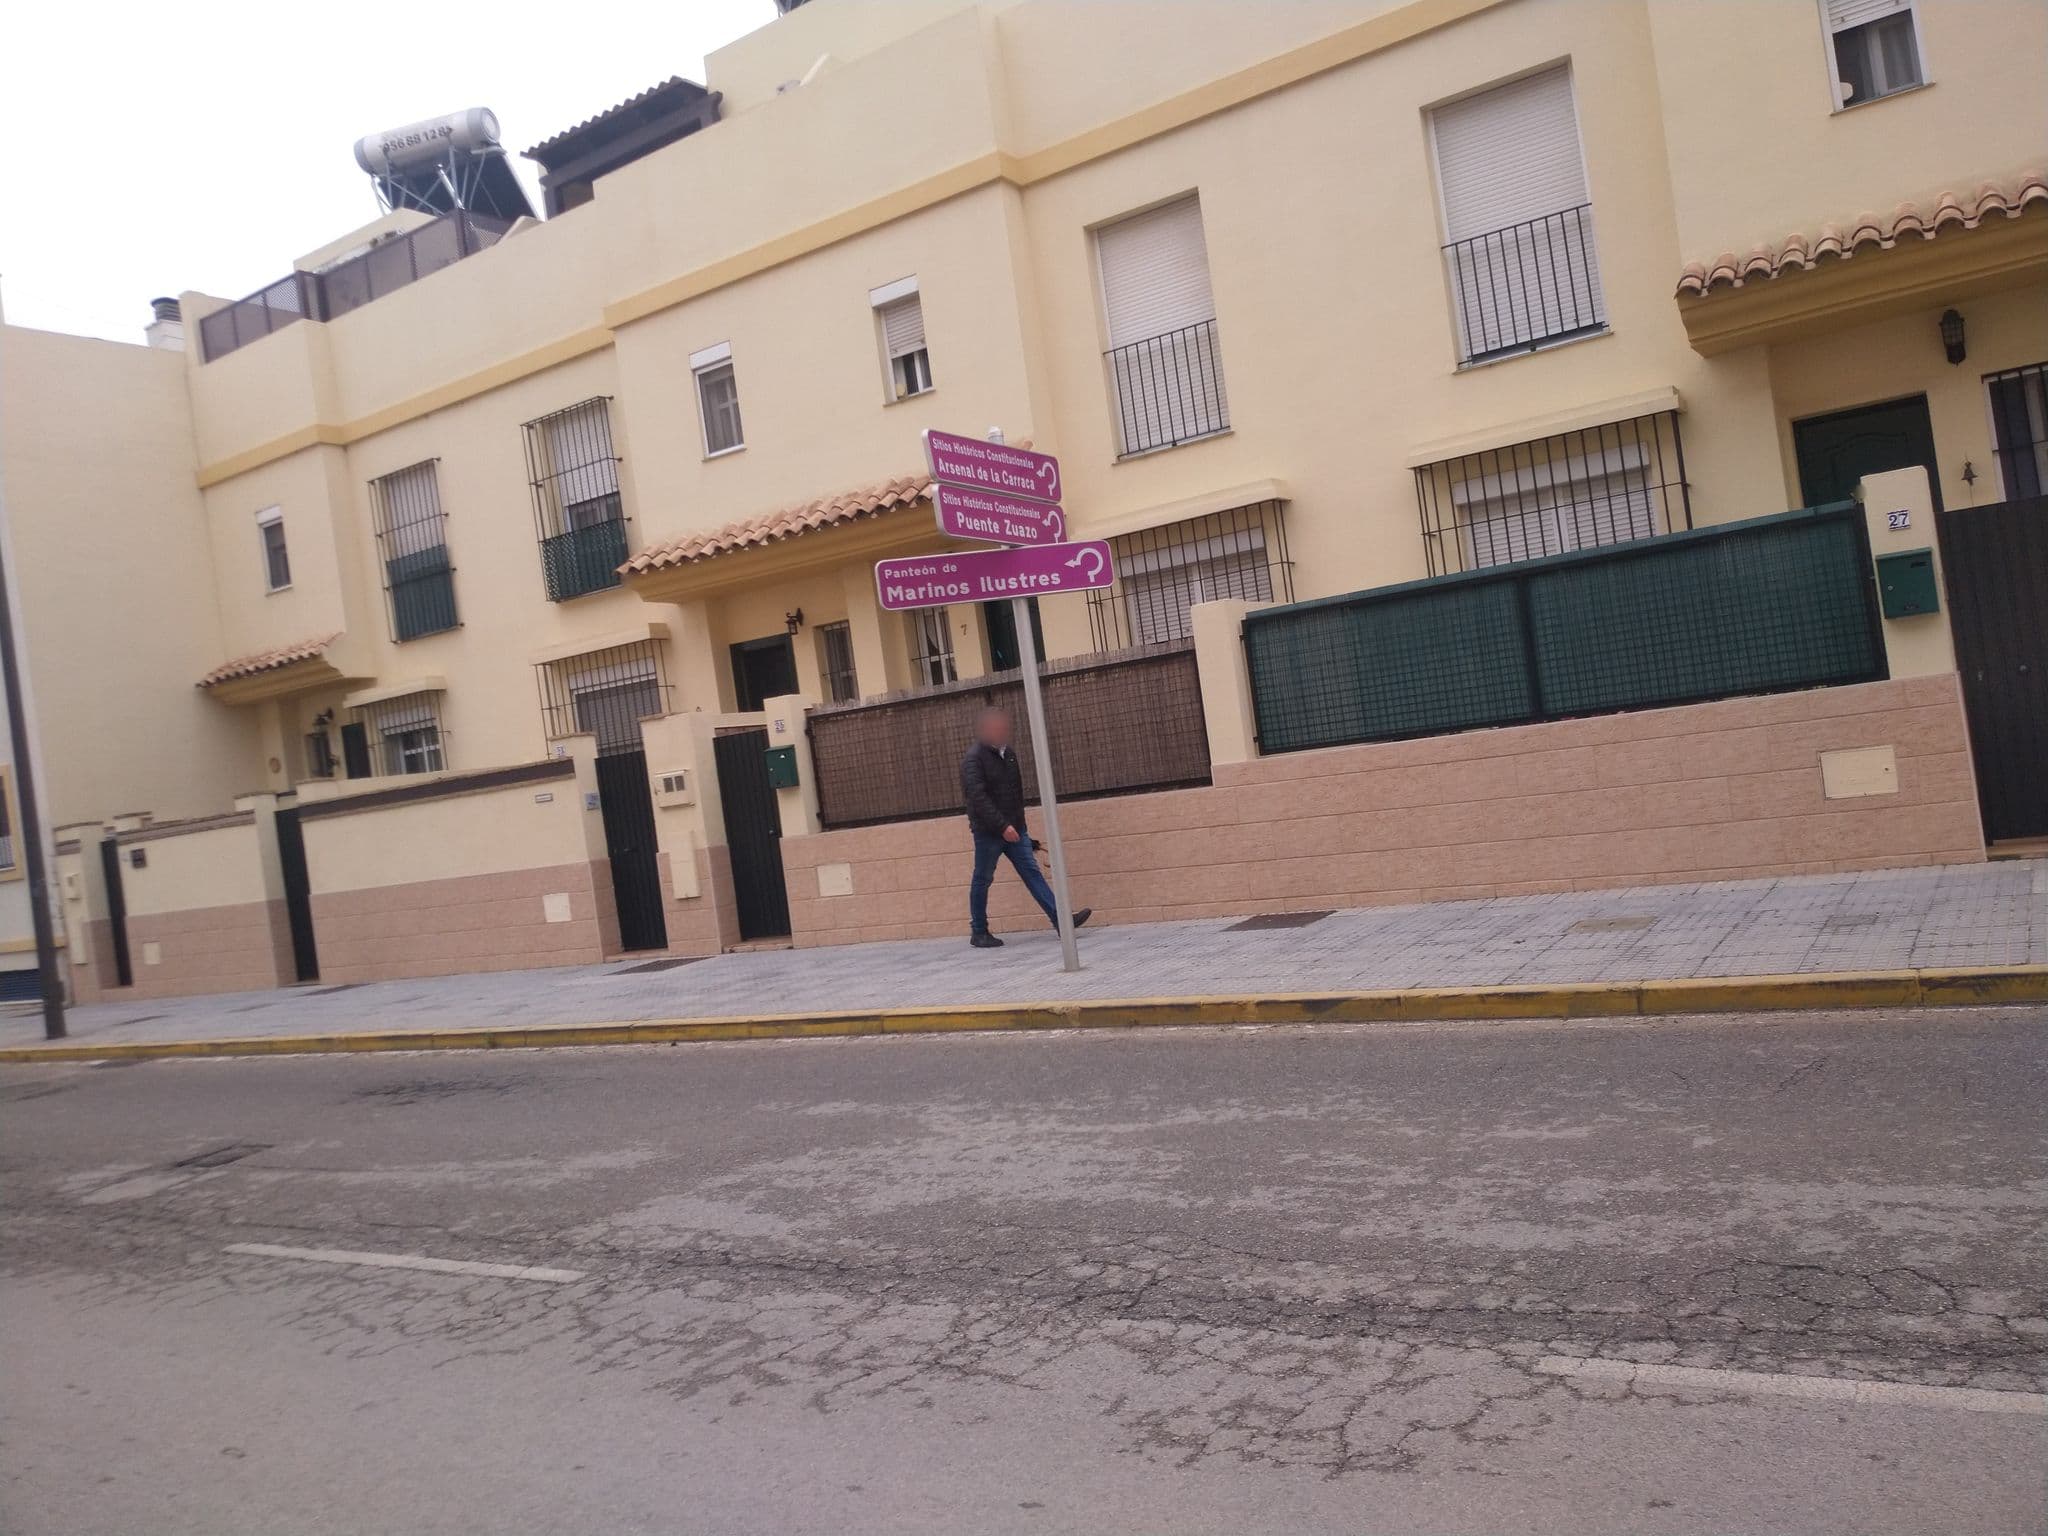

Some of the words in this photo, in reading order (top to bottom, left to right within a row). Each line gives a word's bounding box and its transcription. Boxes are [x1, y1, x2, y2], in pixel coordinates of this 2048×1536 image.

[932, 437, 952, 451] Sitios
[953, 442, 985, 460] Históricos
[987, 448, 1034, 469] Constitucionales
[938, 458, 975, 479] Arsenal
[977, 467, 988, 481] de
[991, 468, 1000, 484] la
[1002, 471, 1036, 491] Carraca
[942, 492, 962, 506] Sitios
[963, 496, 993, 512] Históricos
[994, 501, 1041, 520] Constitucionales
[1889, 513, 1907, 527] 27
[956, 511, 1000, 534] Puente
[1005, 519, 1037, 539] Zuazo
[885, 564, 936, 580] Panteón
[943, 563, 957, 574] de
[887, 582, 970, 602] Marinos
[980, 573, 1061, 593] Ilustres
